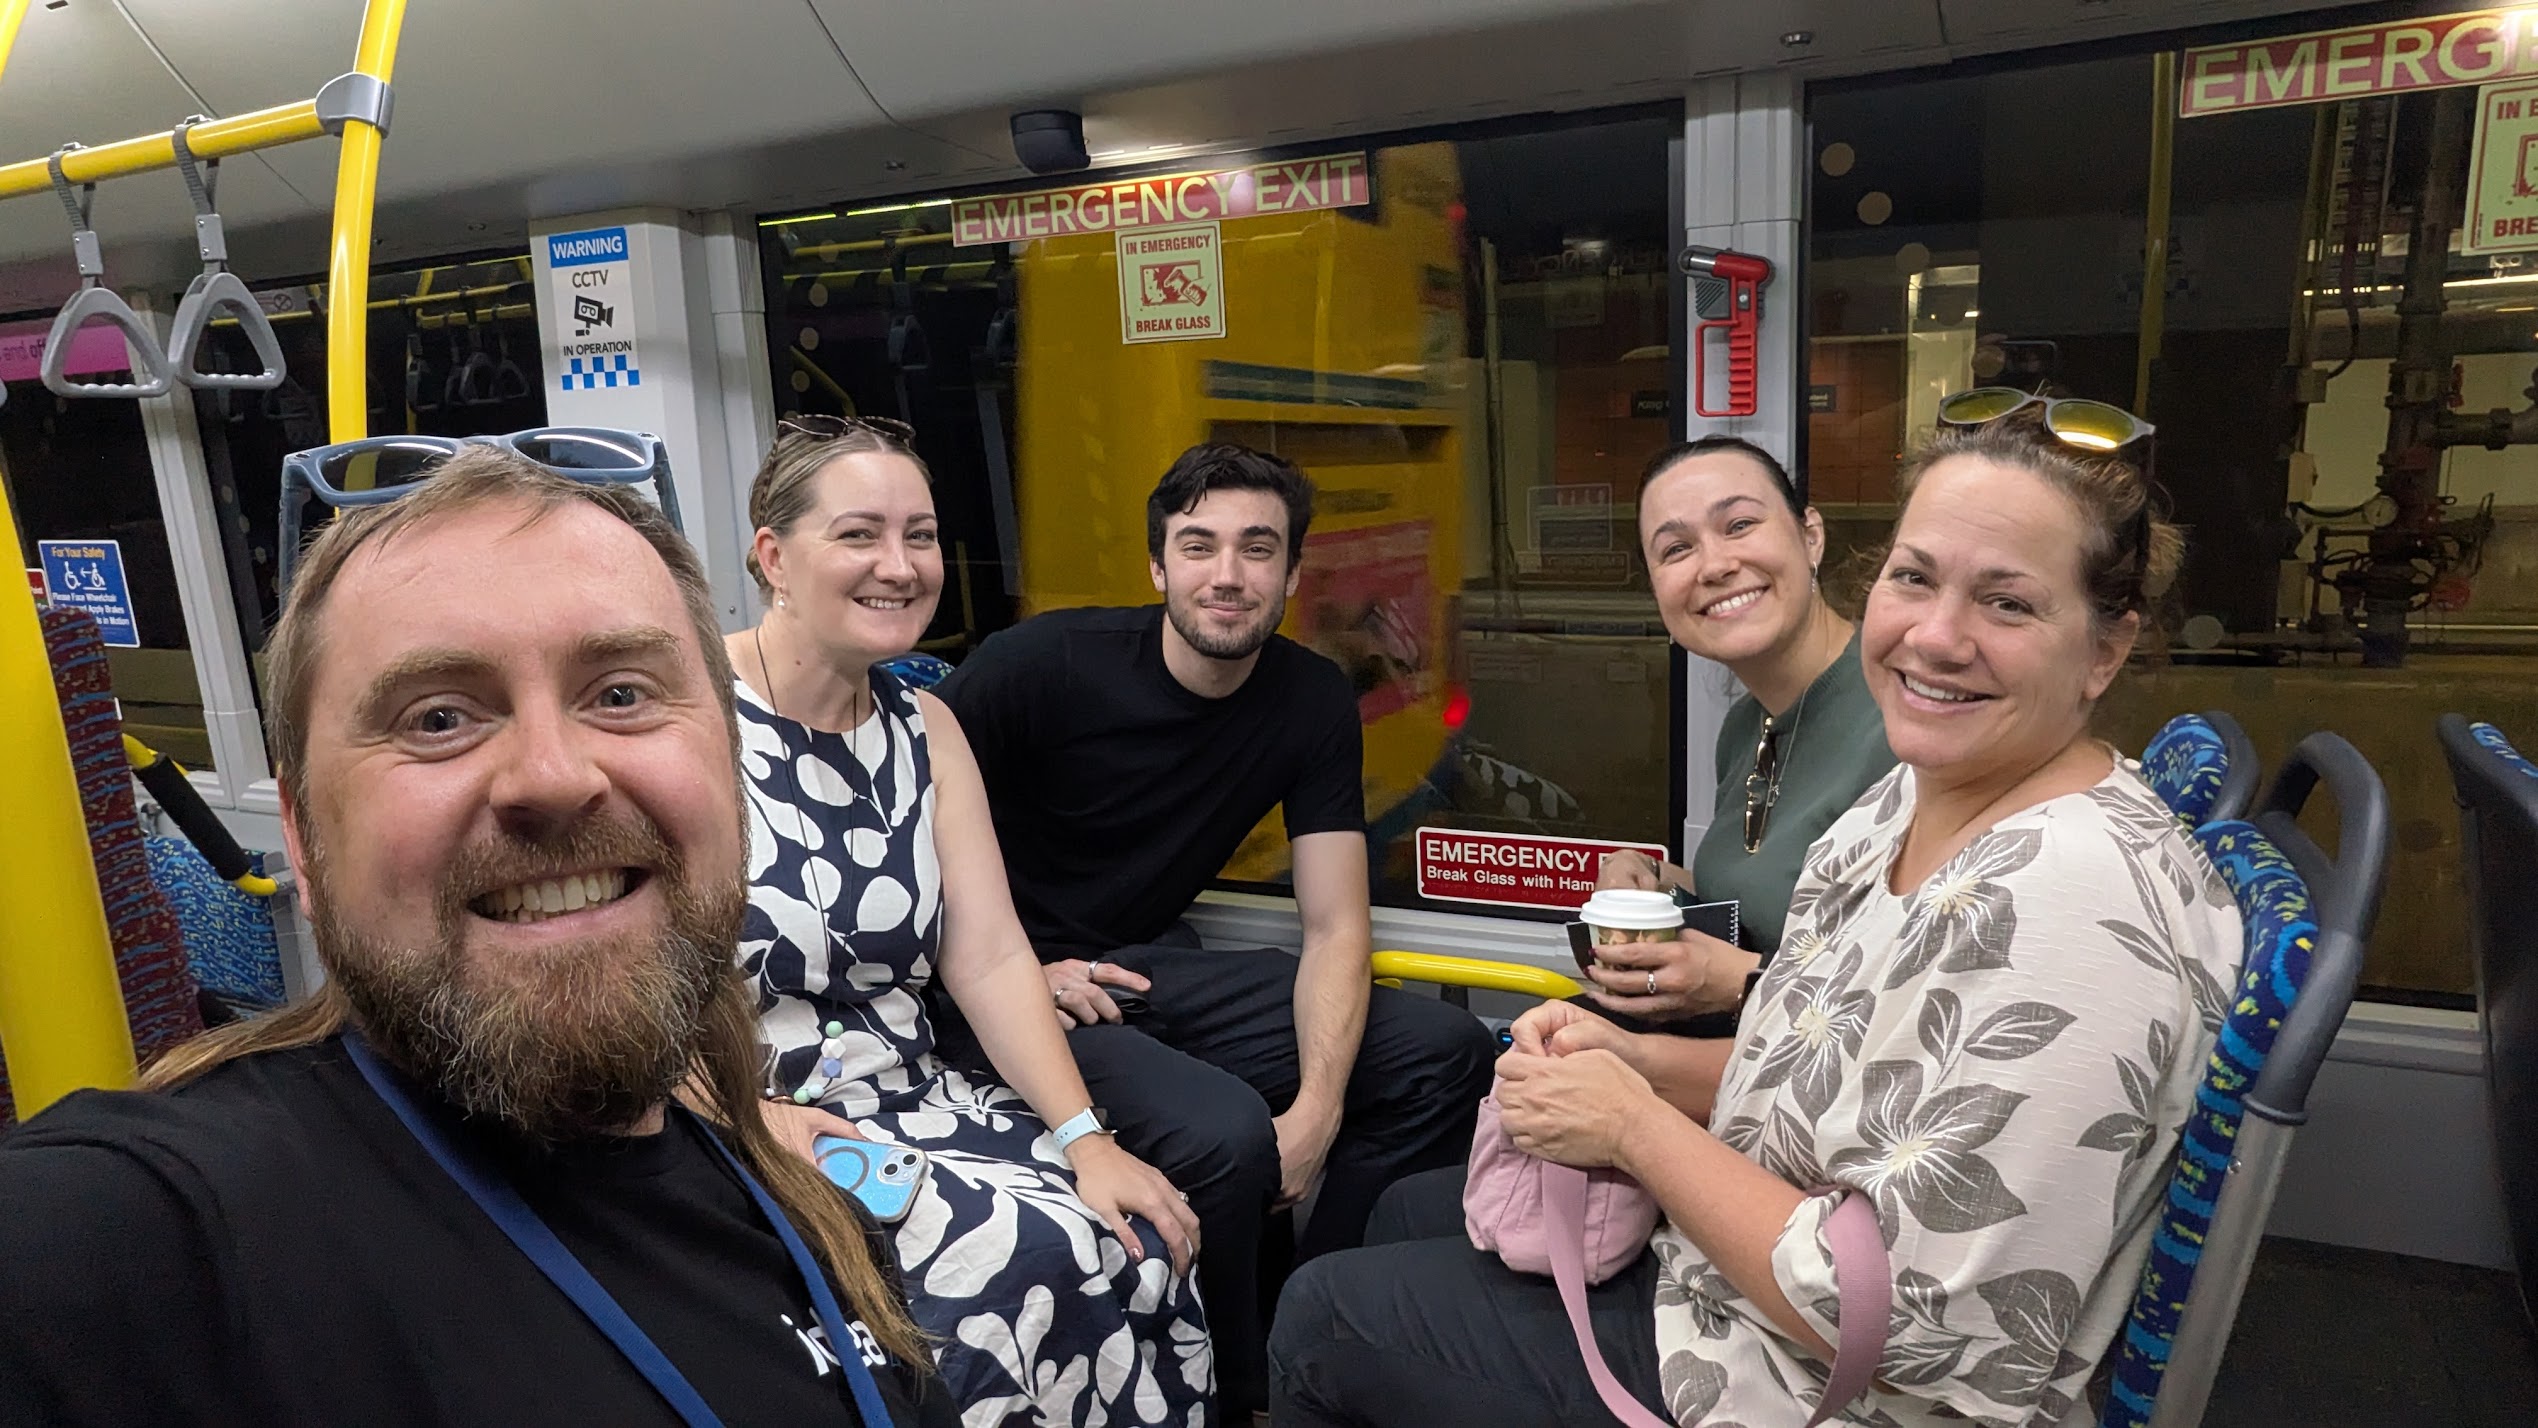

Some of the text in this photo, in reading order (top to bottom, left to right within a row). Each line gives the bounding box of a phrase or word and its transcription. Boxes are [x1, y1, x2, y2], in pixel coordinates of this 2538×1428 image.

[2496, 100, 2521, 120] IN
[958, 157, 1362, 243] EMERGENCY EXIT
[552, 235, 623, 259] WARNING
[1125, 235, 1210, 255] IN EMERGENCY
[572, 269, 609, 288] CCTV
[1136, 319, 1172, 333] BREAK
[1175, 315, 1211, 330] GLASS
[563, 340, 632, 356] IN OPERATION
[51, 546, 105, 560] For Your Safety
[1425, 838, 1591, 873] EMERGENCY
[1427, 865, 1595, 892] Break Glass with Ham
